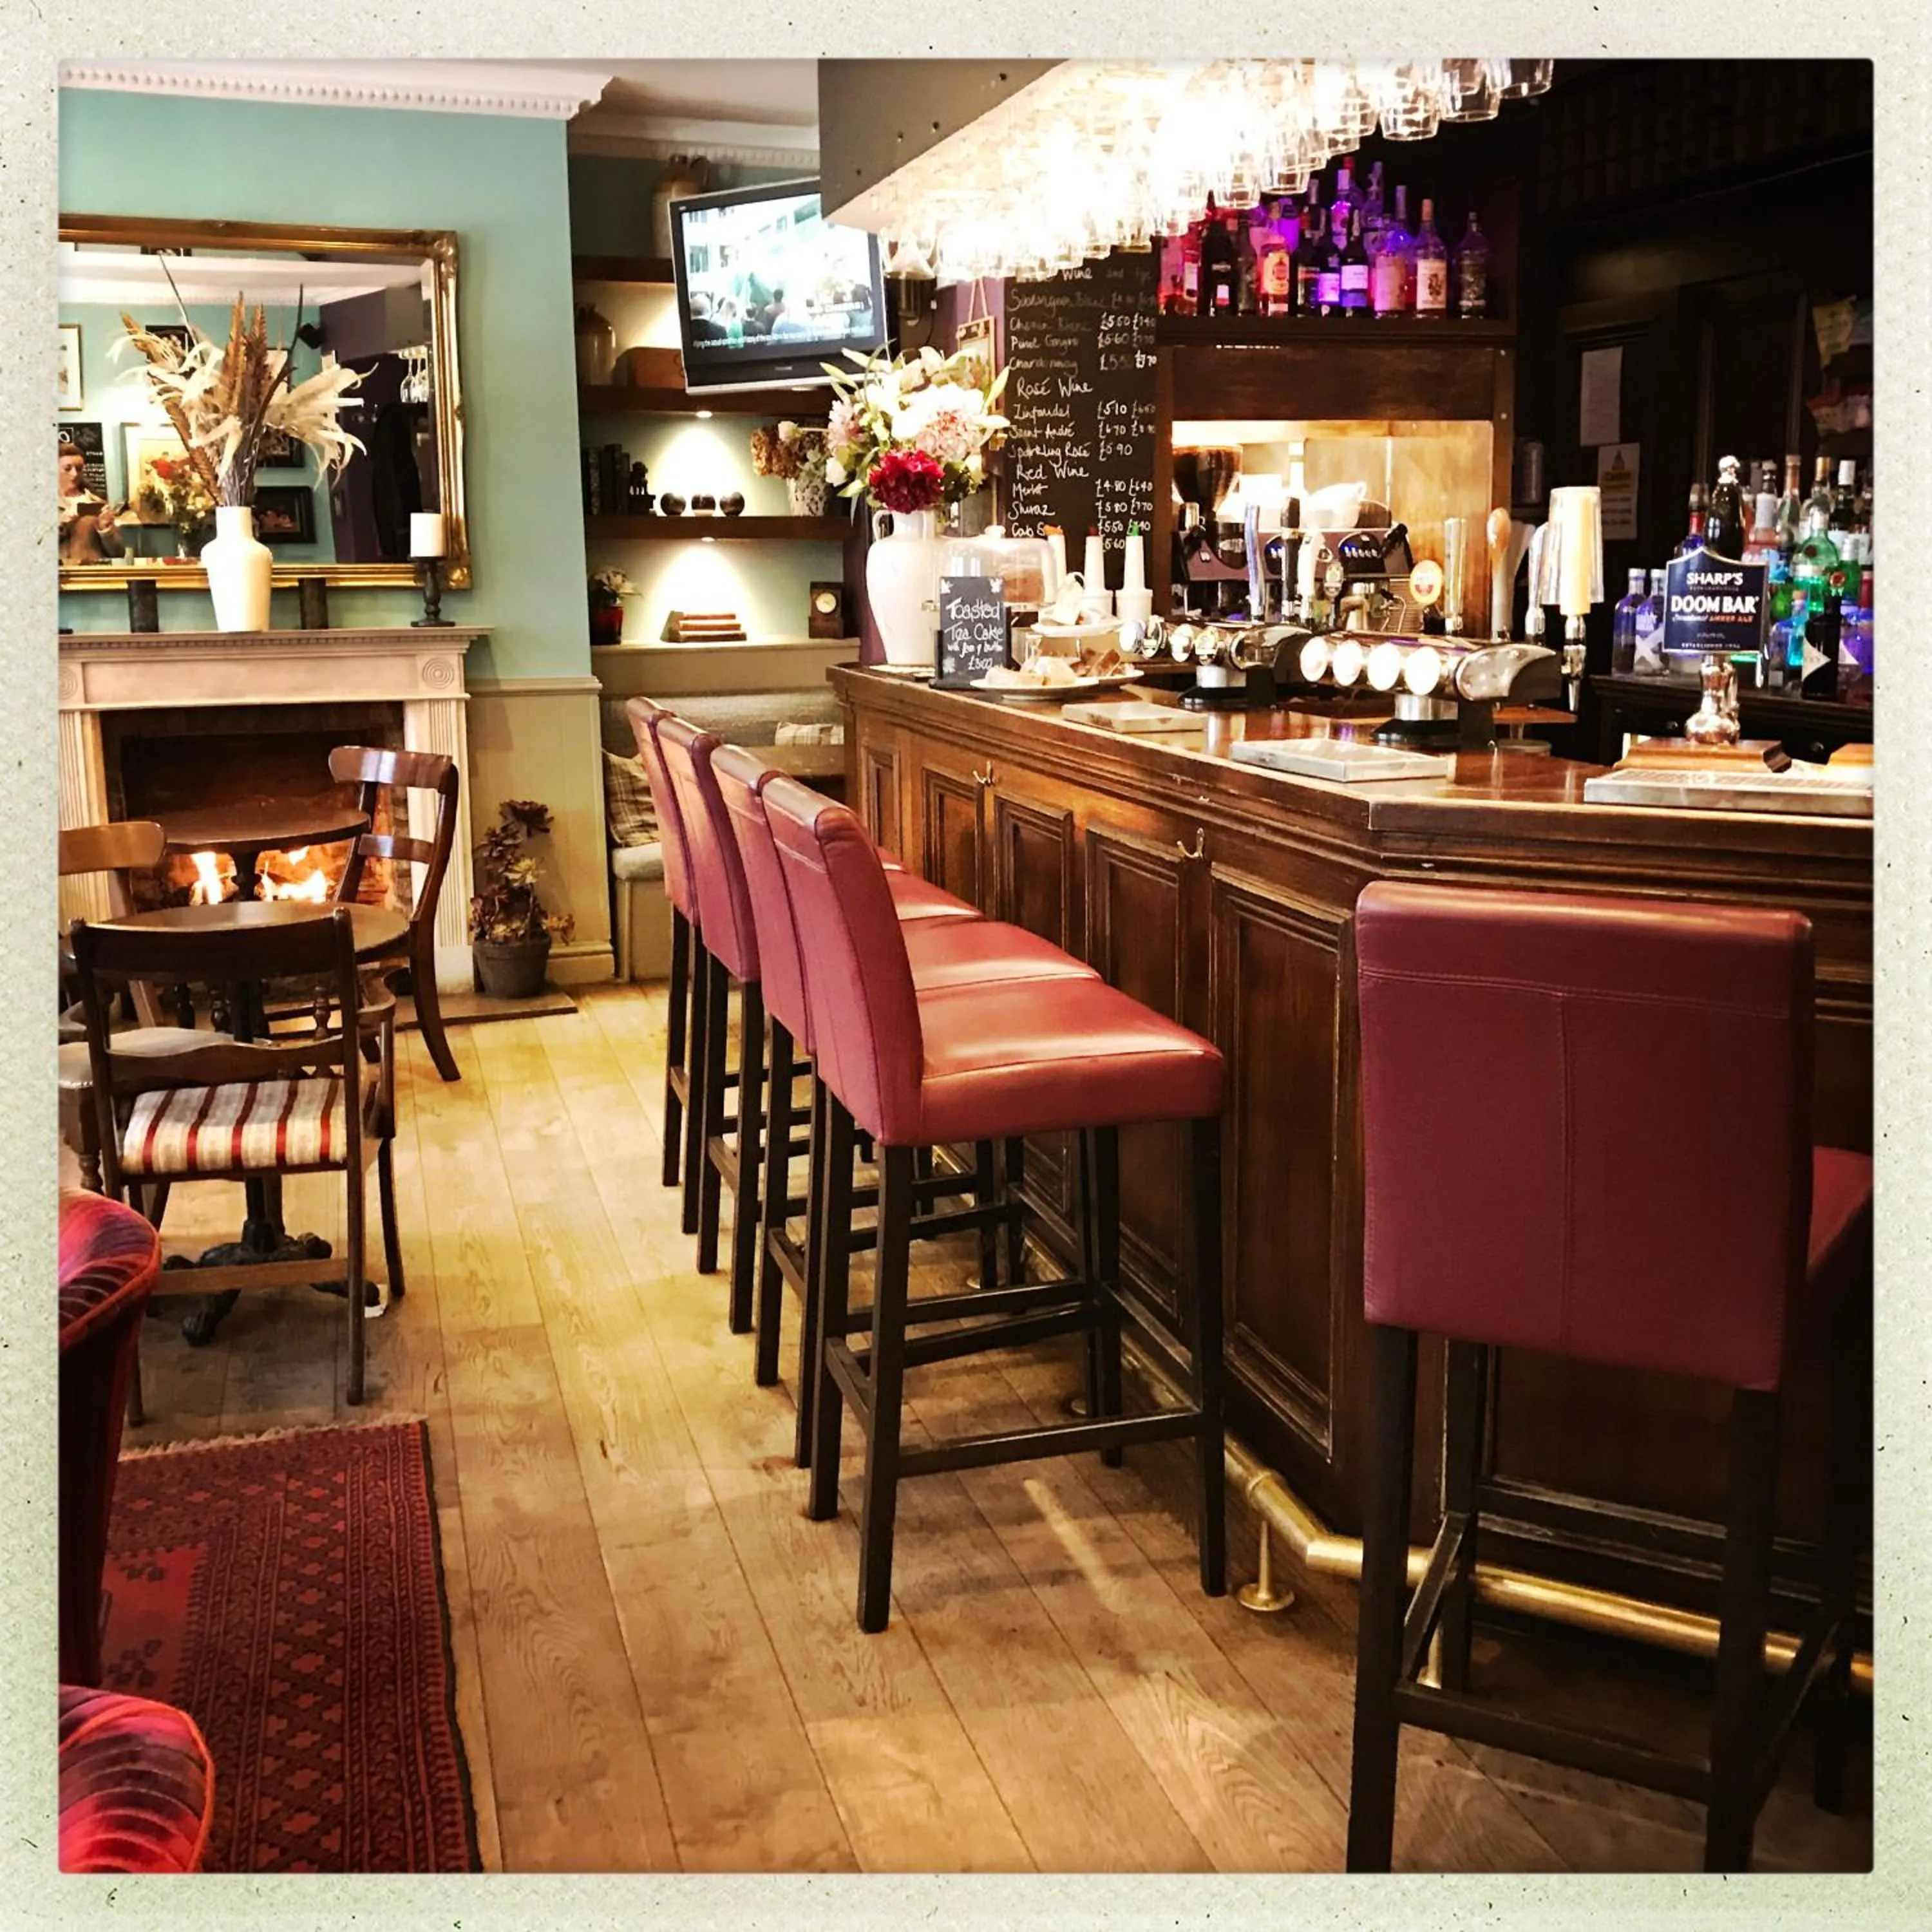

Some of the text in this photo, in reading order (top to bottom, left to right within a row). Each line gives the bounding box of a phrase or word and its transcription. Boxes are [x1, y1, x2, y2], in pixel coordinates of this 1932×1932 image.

[1016, 377, 1093, 399] Rosé Wine
[1016, 459, 1090, 481] Red Wine
[1008, 500, 1056, 520] Shiraz
[1012, 522, 1034, 537] Cab
[1686, 572, 1743, 585] SHARP'S
[945, 597, 1000, 622] Toasted
[1671, 594, 1756, 613] DOOM BAR
[944, 621, 1004, 641] Tea Cake
